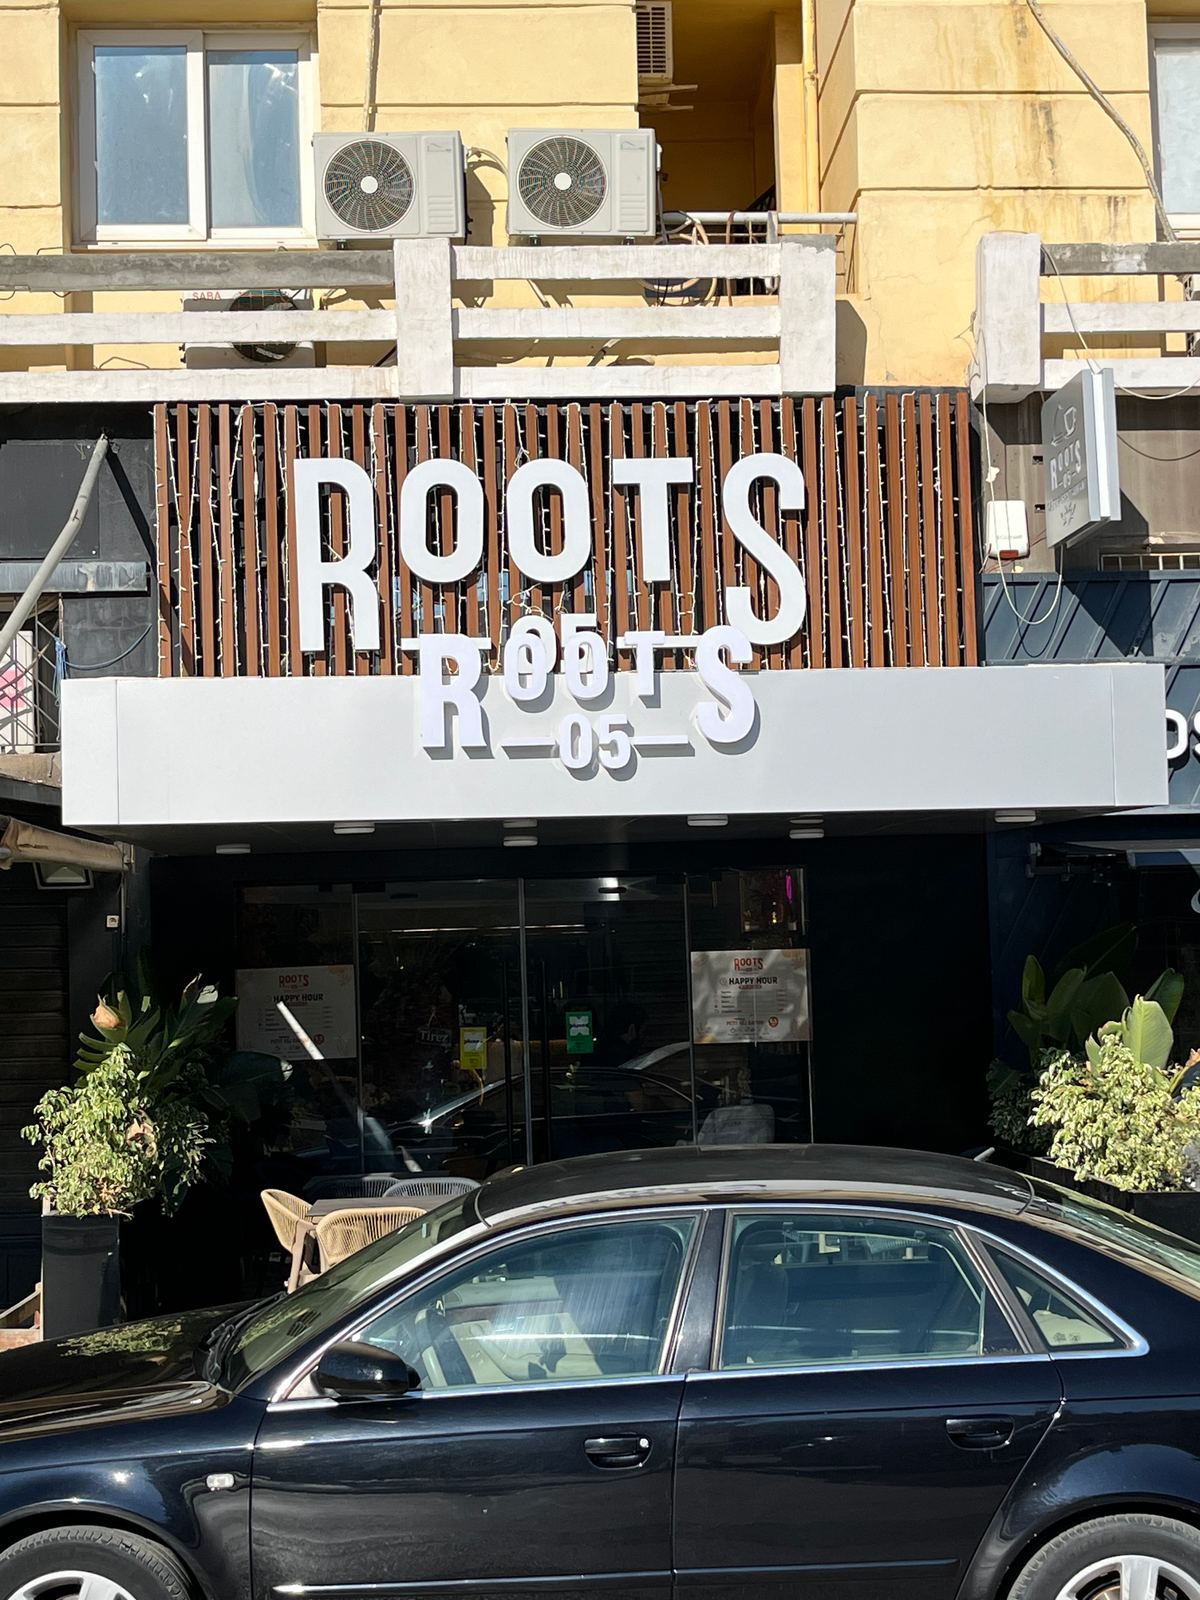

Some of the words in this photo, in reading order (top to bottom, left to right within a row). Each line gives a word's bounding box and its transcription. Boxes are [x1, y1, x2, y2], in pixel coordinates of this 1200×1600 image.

[193, 291, 222, 301] SABA
[1050, 439, 1082, 491] ROOTS
[293, 452, 807, 653] ROOTS
[418, 624, 756, 748] ROOTS
[558, 713, 633, 770] 05
[729, 977, 755, 985] HAPPY
[756, 976, 778, 985] HOUR
[734, 957, 764, 971] ROOTS
[302, 992, 324, 1002] HOUR
